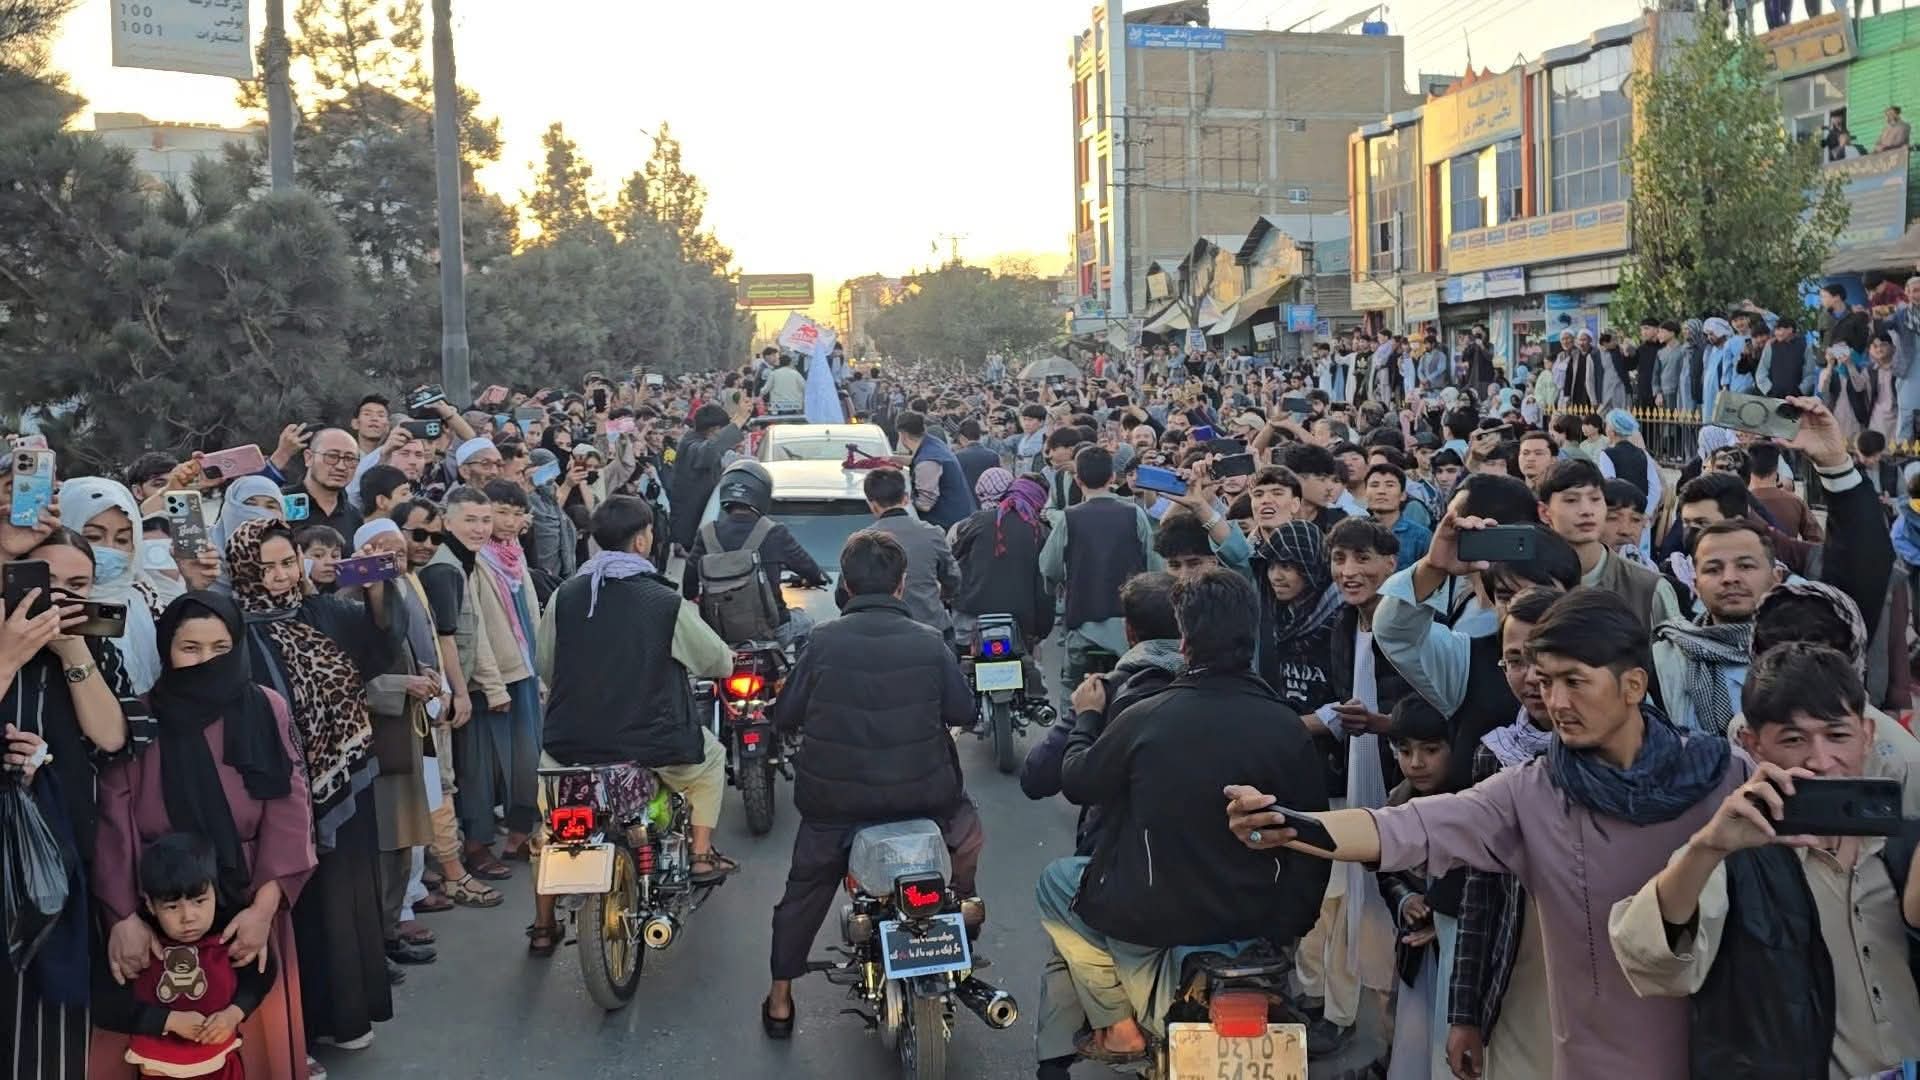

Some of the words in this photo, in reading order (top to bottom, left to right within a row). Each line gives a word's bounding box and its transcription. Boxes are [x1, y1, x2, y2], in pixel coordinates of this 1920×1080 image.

[121, 3, 152, 18] 100
[120, 20, 163, 37] 1001
[1279, 662, 1327, 682] RADA
[1217, 1062, 1275, 1080] 5435
